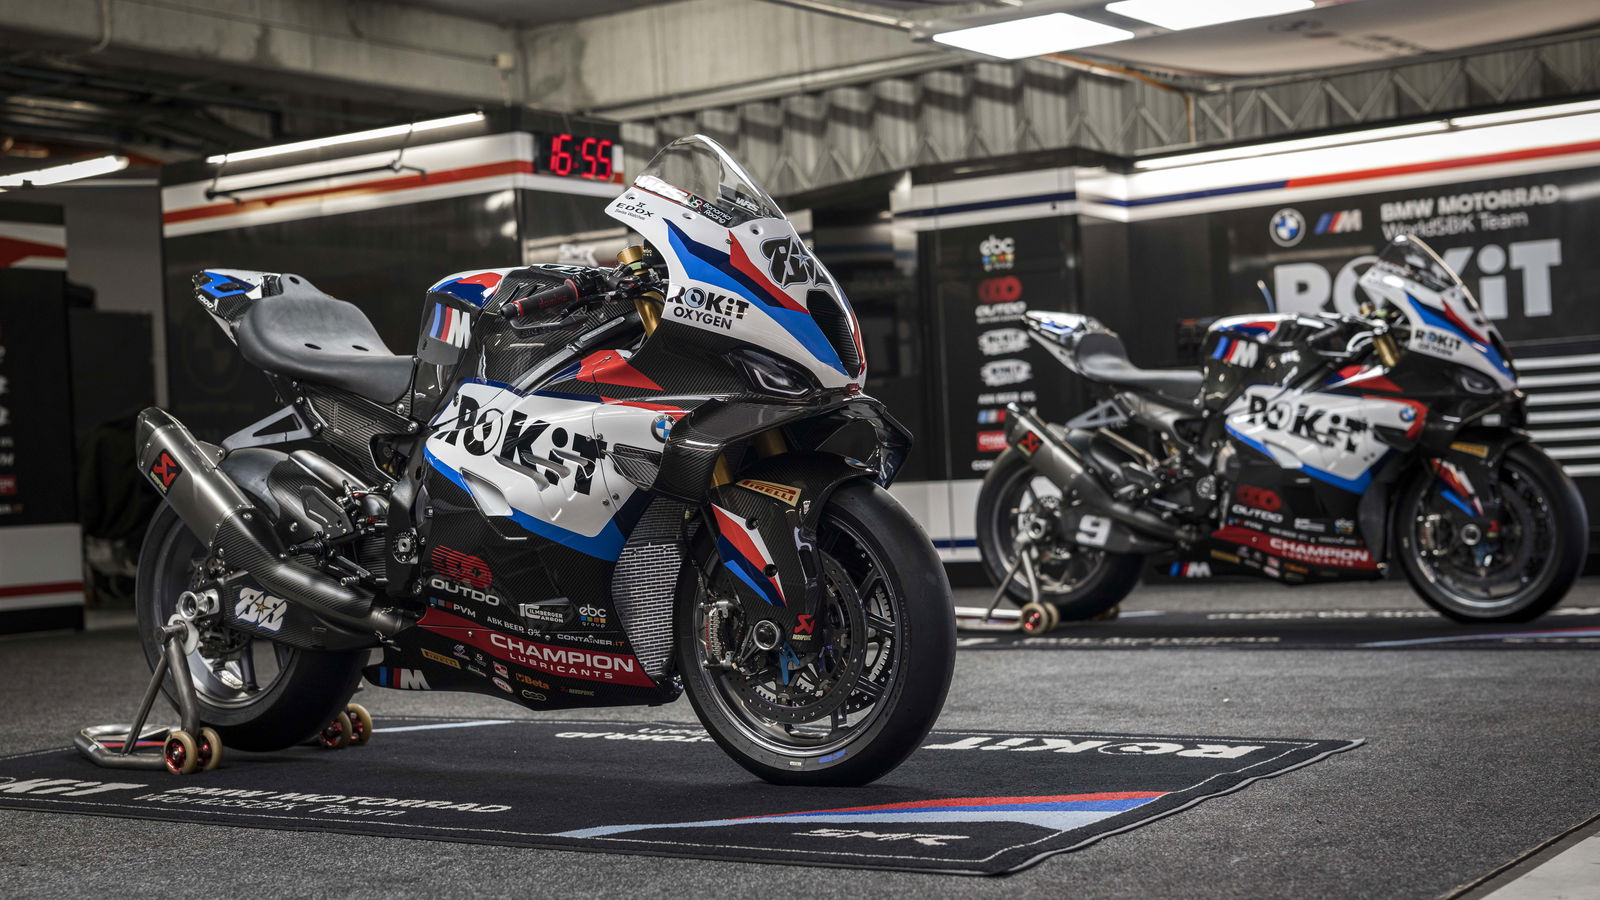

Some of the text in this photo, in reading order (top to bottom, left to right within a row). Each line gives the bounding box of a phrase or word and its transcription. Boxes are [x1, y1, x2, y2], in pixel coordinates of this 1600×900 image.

[550, 133, 613, 180] 16:55
[616, 202, 654, 217] EDOX
[702, 202, 732, 220] Bonamici
[1380, 184, 1560, 222] BMW MOTORRAD
[703, 210, 726, 224] Racing
[1479, 210, 1529, 230] Team
[674, 306, 732, 330] OXYGEN
[433, 394, 608, 496] ROKiT
[742, 480, 796, 502] PIRELLI
[1075, 514, 1111, 546] 9
[1270, 537, 1369, 562] CHAMPION
[431, 578, 499, 606] OUTDO
[453, 603, 476, 618] PVM
[579, 604, 606, 618] ebc
[487, 616, 503, 626] ABK
[504, 621, 525, 633] BEER
[490, 633, 634, 672] CHAMPION
[510, 653, 613, 679] LUBRICANTS
[921, 736, 1265, 759] ROKiT
[268, 791, 512, 813] MOTORRAD
